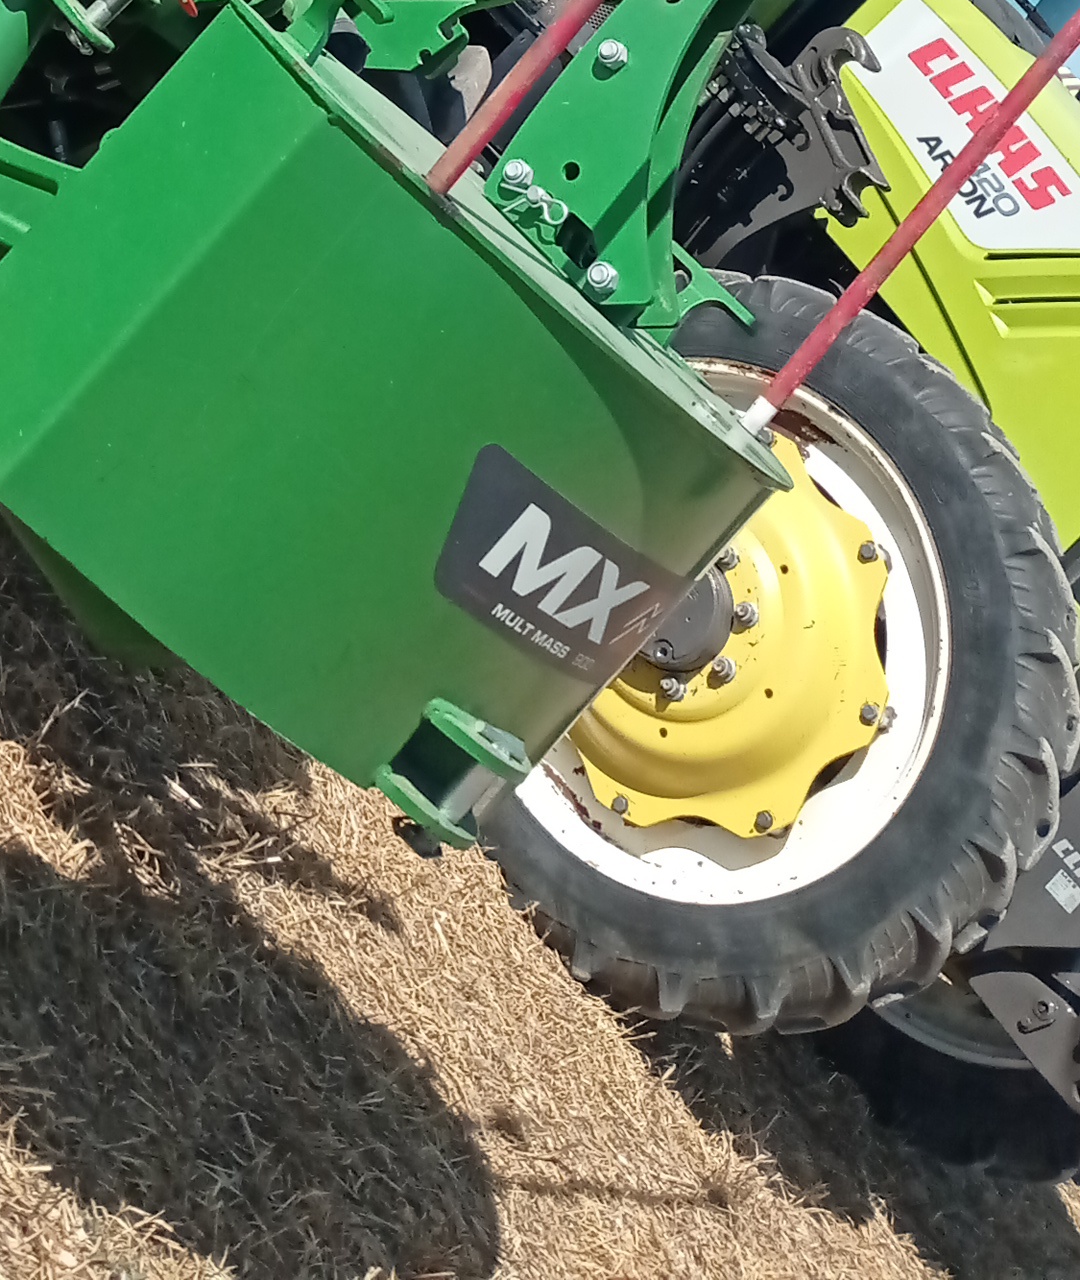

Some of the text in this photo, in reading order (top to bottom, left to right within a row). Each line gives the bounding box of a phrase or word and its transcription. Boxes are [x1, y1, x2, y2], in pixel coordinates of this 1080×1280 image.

[908, 37, 1072, 210] CLAAS
[478, 502, 651, 645] MX
[531, 630, 571, 659] MASS
